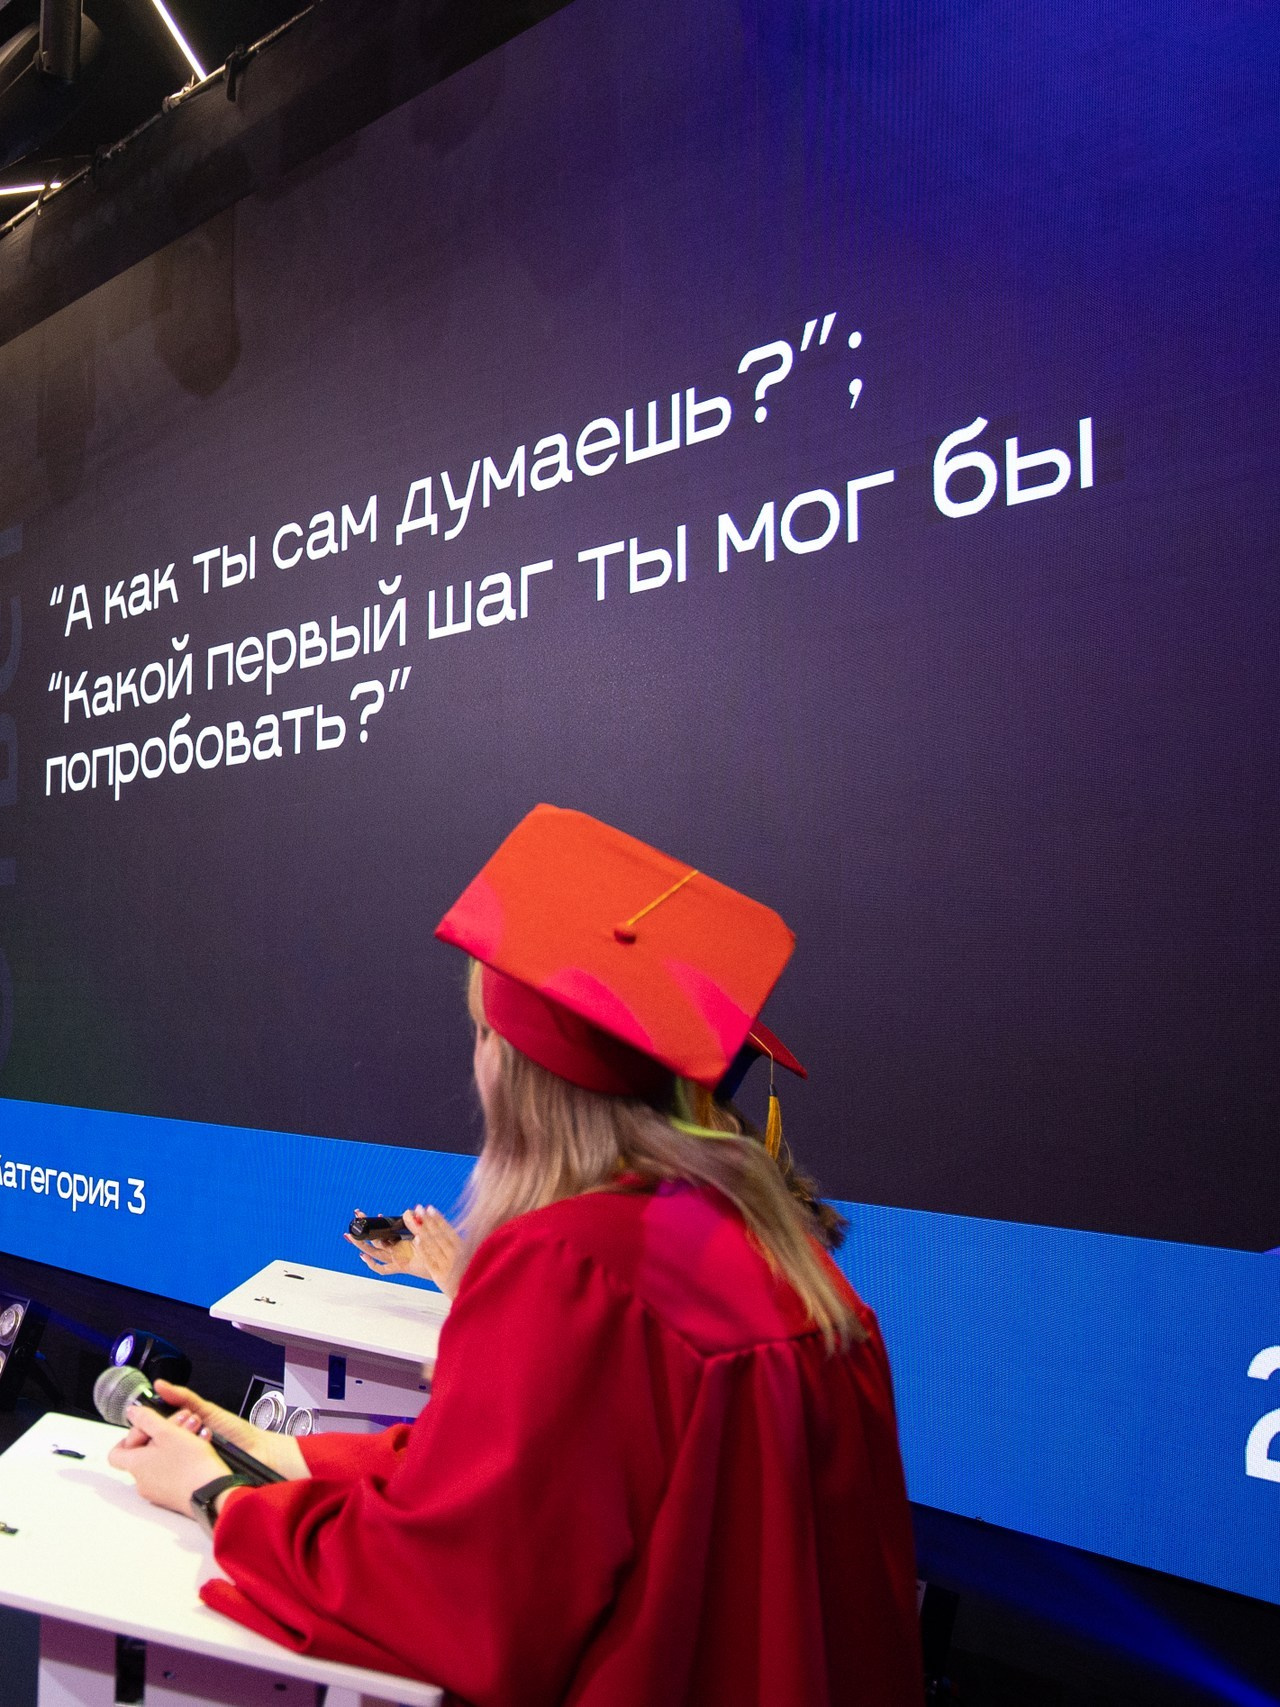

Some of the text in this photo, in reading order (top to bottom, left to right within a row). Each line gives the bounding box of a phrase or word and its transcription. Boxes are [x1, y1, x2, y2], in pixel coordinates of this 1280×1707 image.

[47, 416, 1095, 724] “Какой первый шаг ты мог бы
[104, 562, 179, 625] как
[192, 535, 257, 595] ты
[272, 494, 377, 570] сам
[45, 665, 413, 802] попробовать?”
[127, 1176, 147, 1216] 3
